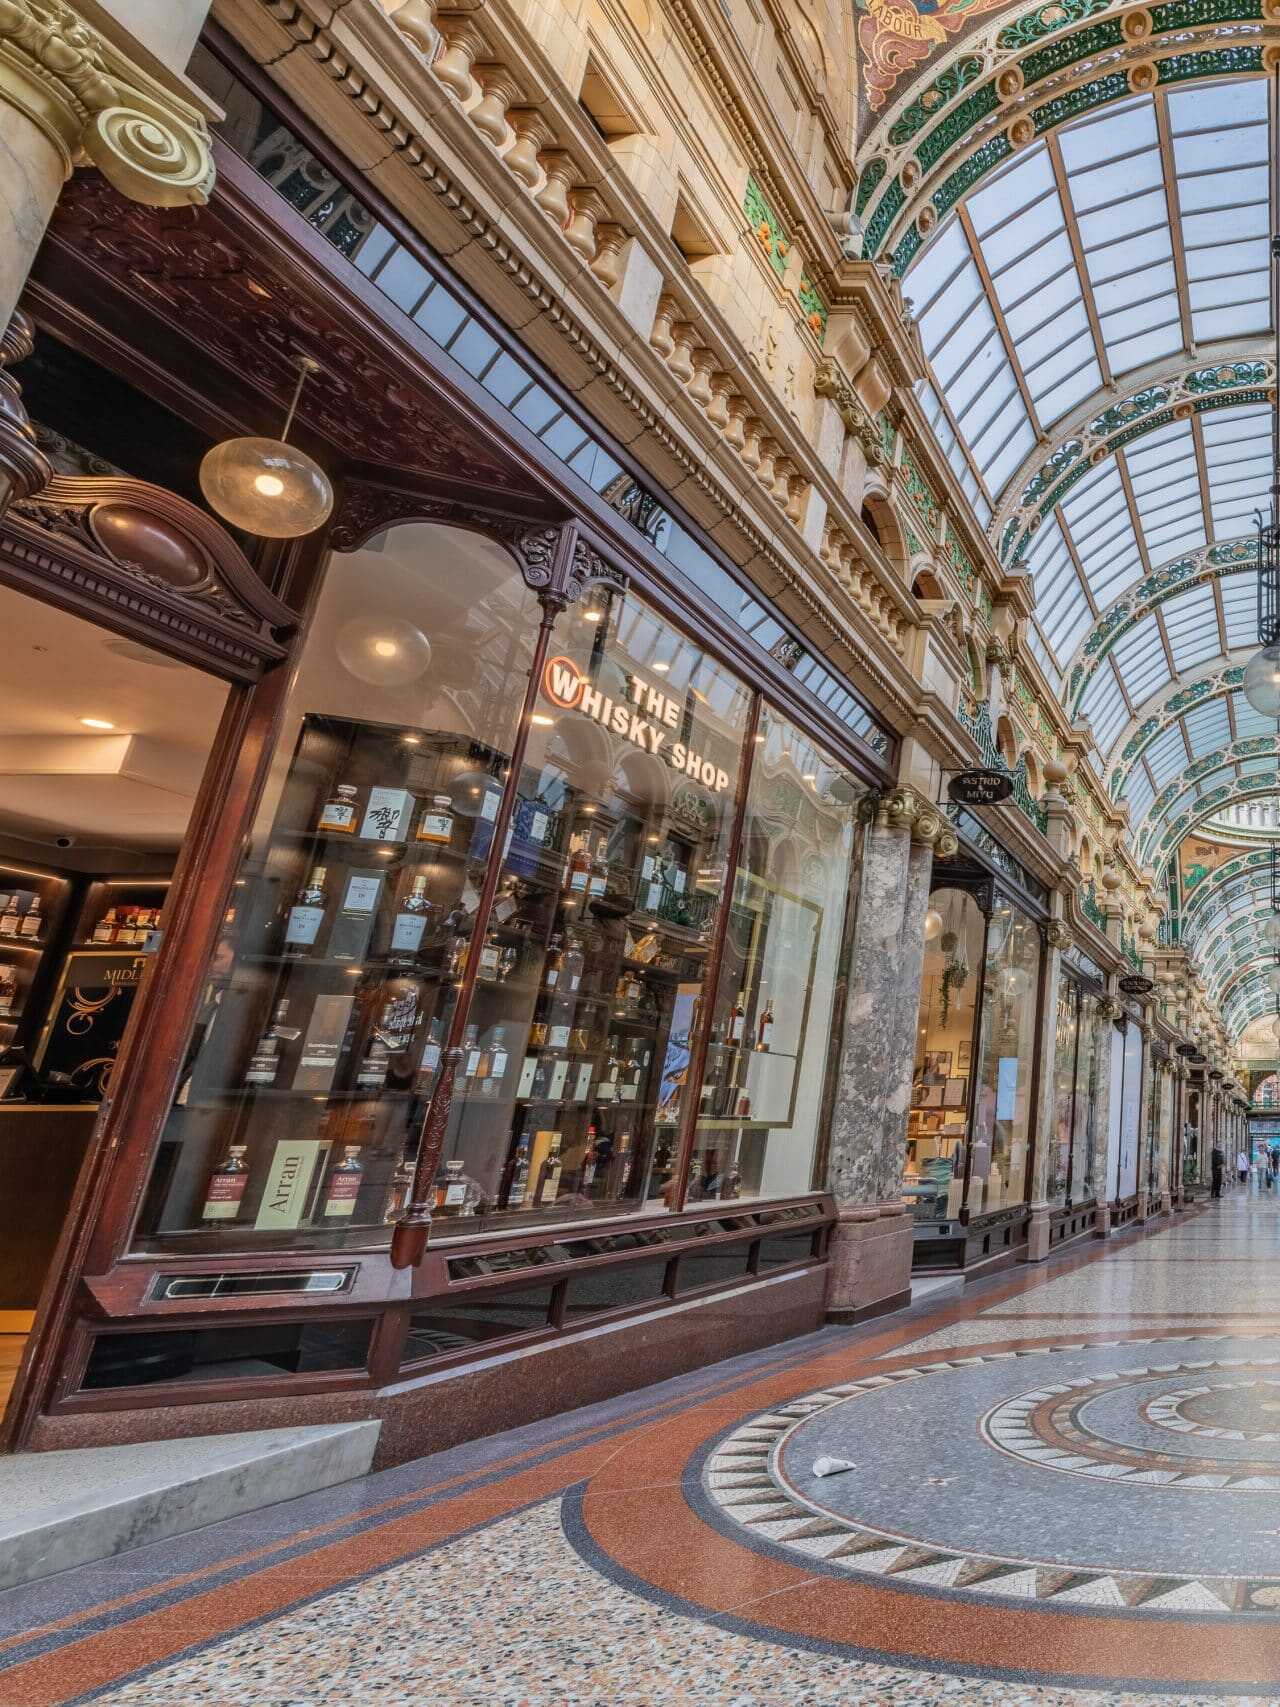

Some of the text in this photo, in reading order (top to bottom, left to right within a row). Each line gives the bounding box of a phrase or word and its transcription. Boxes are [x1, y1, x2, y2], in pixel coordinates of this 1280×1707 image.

[868, 0, 923, 38] LABOUR
[550, 662, 731, 793] WHISKY SHOP
[630, 676, 681, 729] THE
[268, 1154, 300, 1214] Arran
